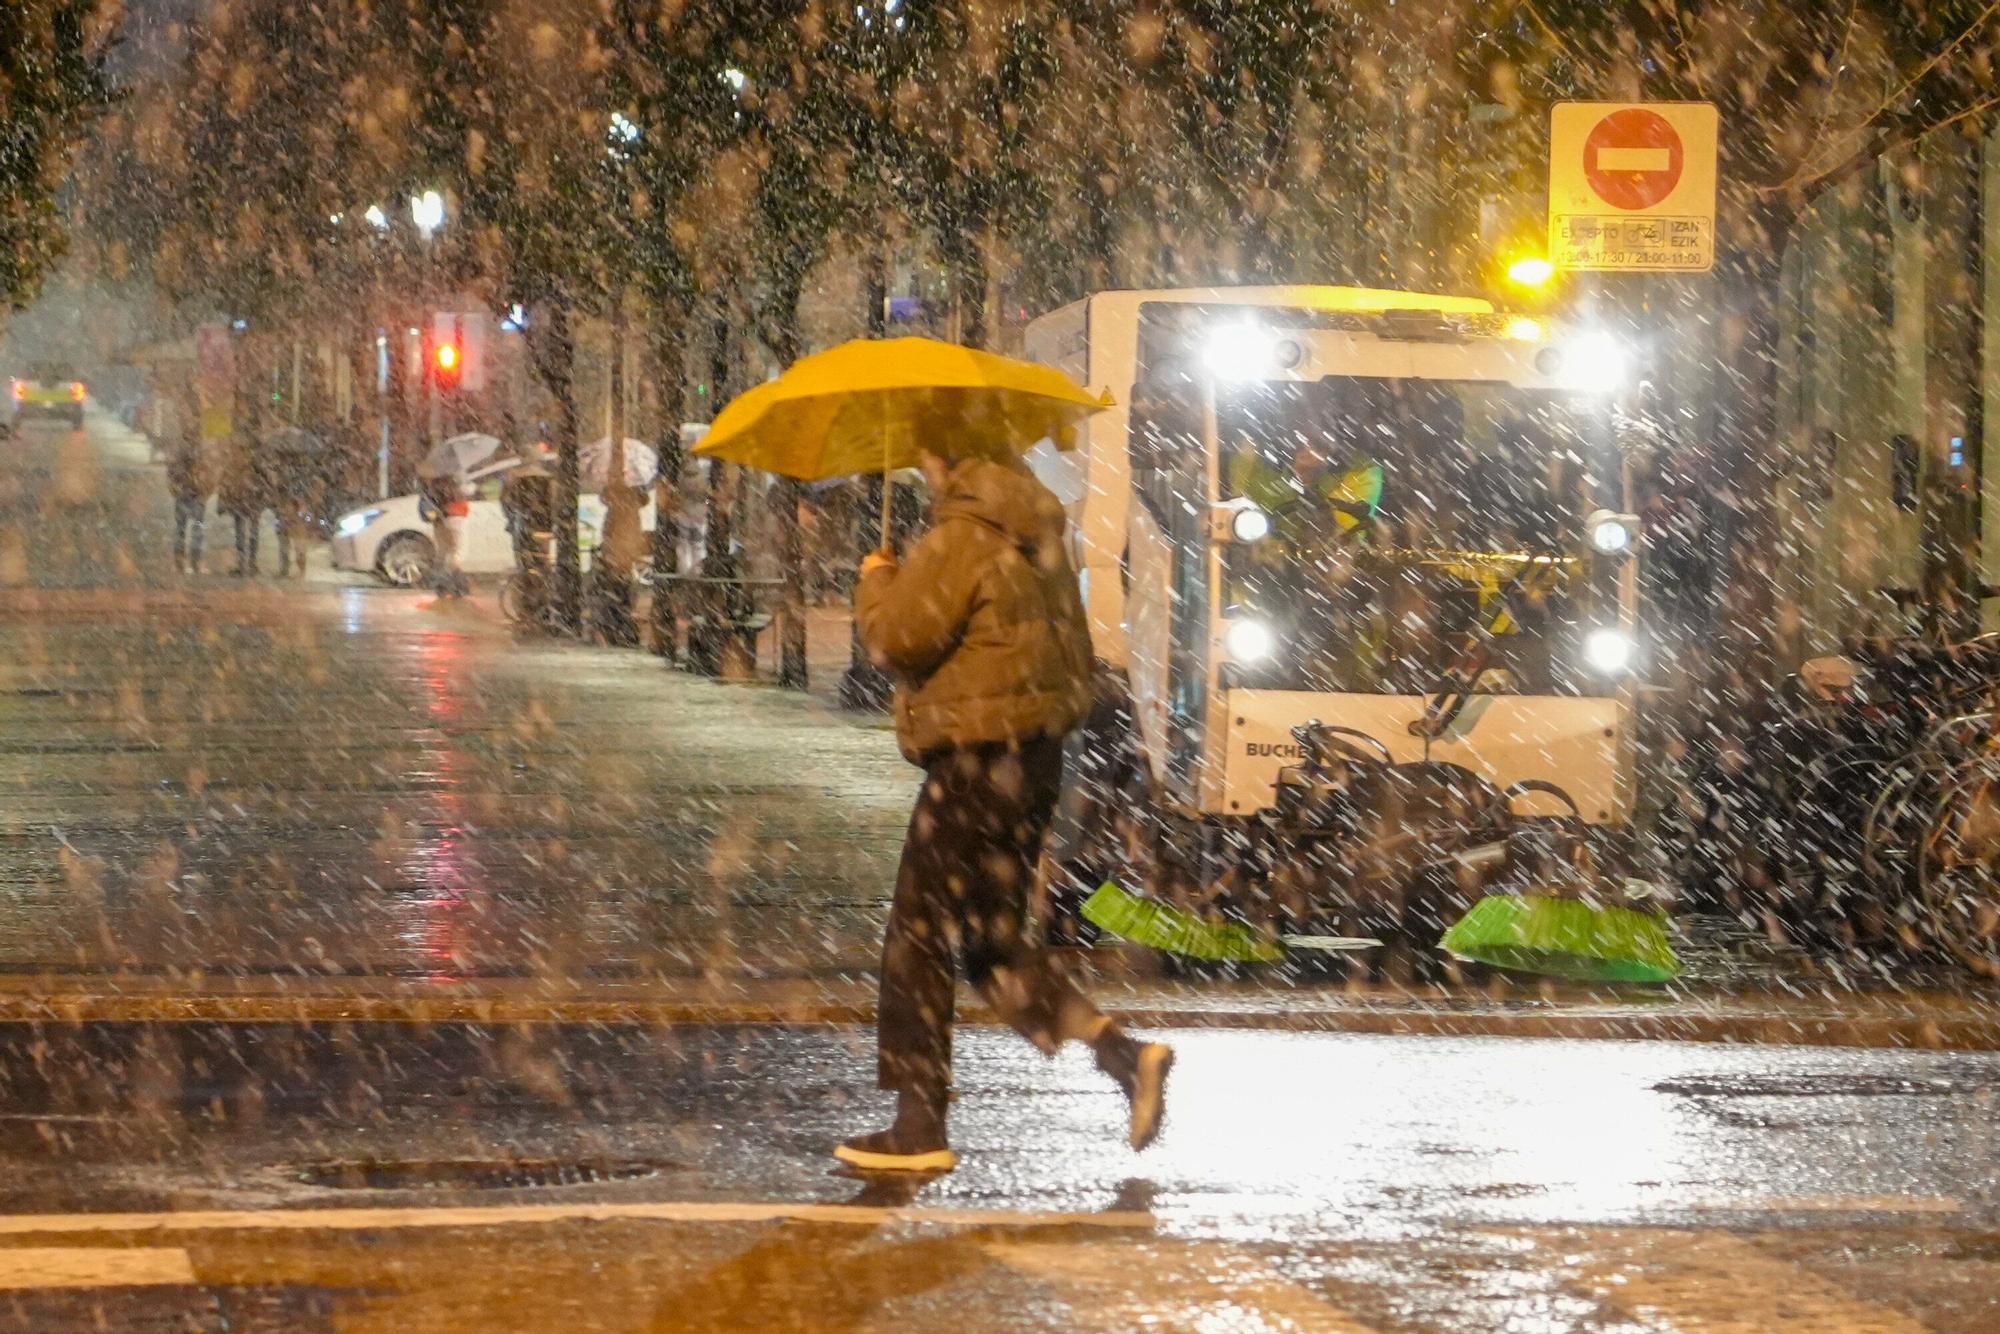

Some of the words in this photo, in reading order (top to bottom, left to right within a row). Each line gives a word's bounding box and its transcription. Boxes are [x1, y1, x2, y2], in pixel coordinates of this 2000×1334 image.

[1671, 221, 1699, 233] IZAN
[1671, 236, 1698, 248] EZIK
[1246, 743, 1309, 759] BUCHE
